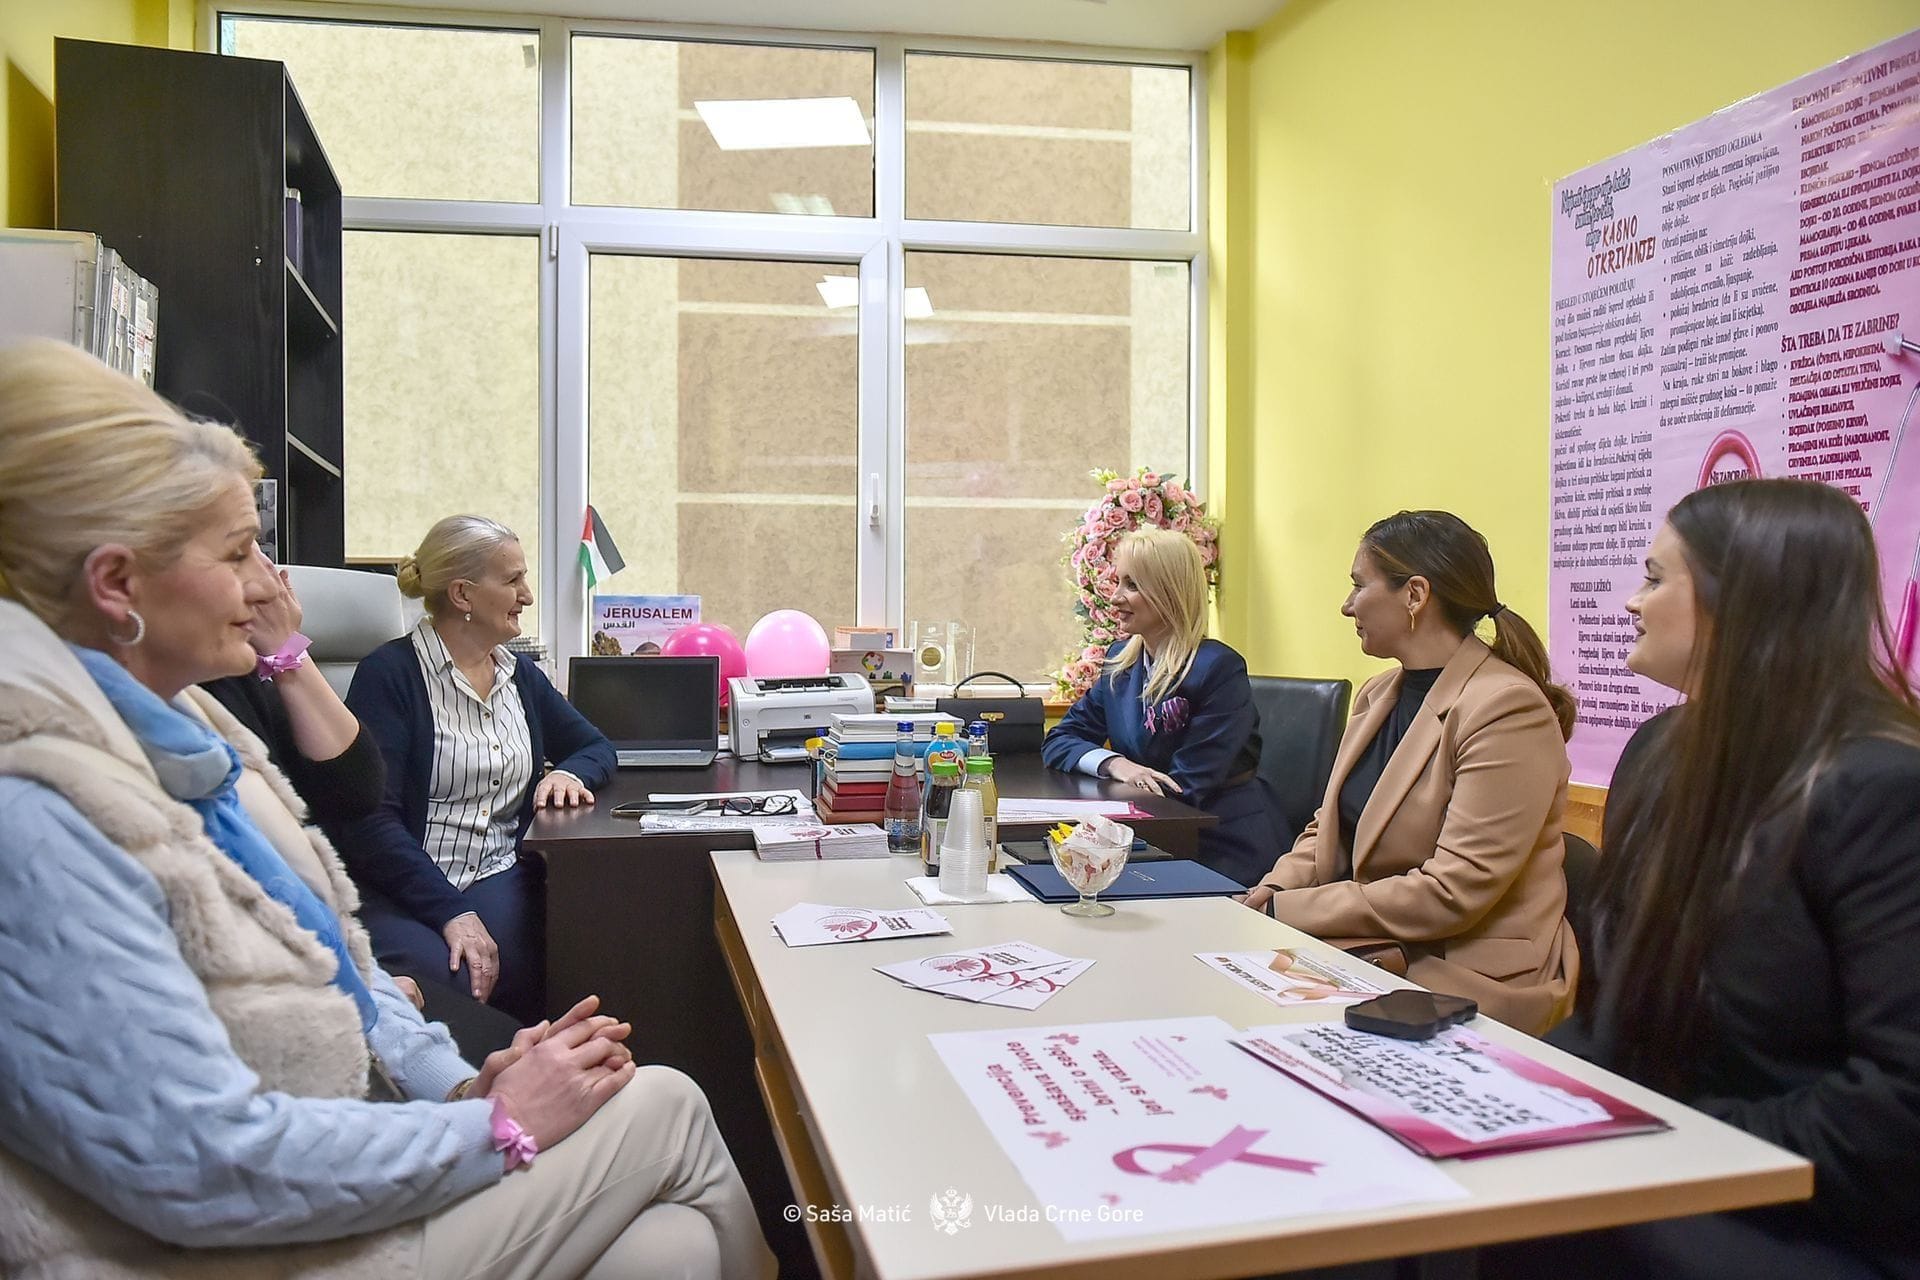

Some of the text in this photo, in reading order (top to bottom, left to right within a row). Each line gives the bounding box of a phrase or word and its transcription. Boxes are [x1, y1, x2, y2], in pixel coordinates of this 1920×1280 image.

[1602, 212, 1637, 248] KASNO
[1587, 234, 1655, 281] OTKRIVANJE!
[1781, 313, 1899, 352] ŠTA TREBA DA TE ZABRINE?
[603, 608, 692, 619] JERUSALEM
[603, 621, 635, 630] القدس
[1044, 1043, 1077, 1068] sebi,
[1092, 1050, 1132, 1083] važna.
[986, 1063, 1046, 1125] Prevencija
[1007, 1042, 1087, 1121] spašava živote
[1074, 1079, 1114, 1106] brini
[1121, 1084, 1146, 1097] si
[1138, 1097, 1174, 1116] jer
